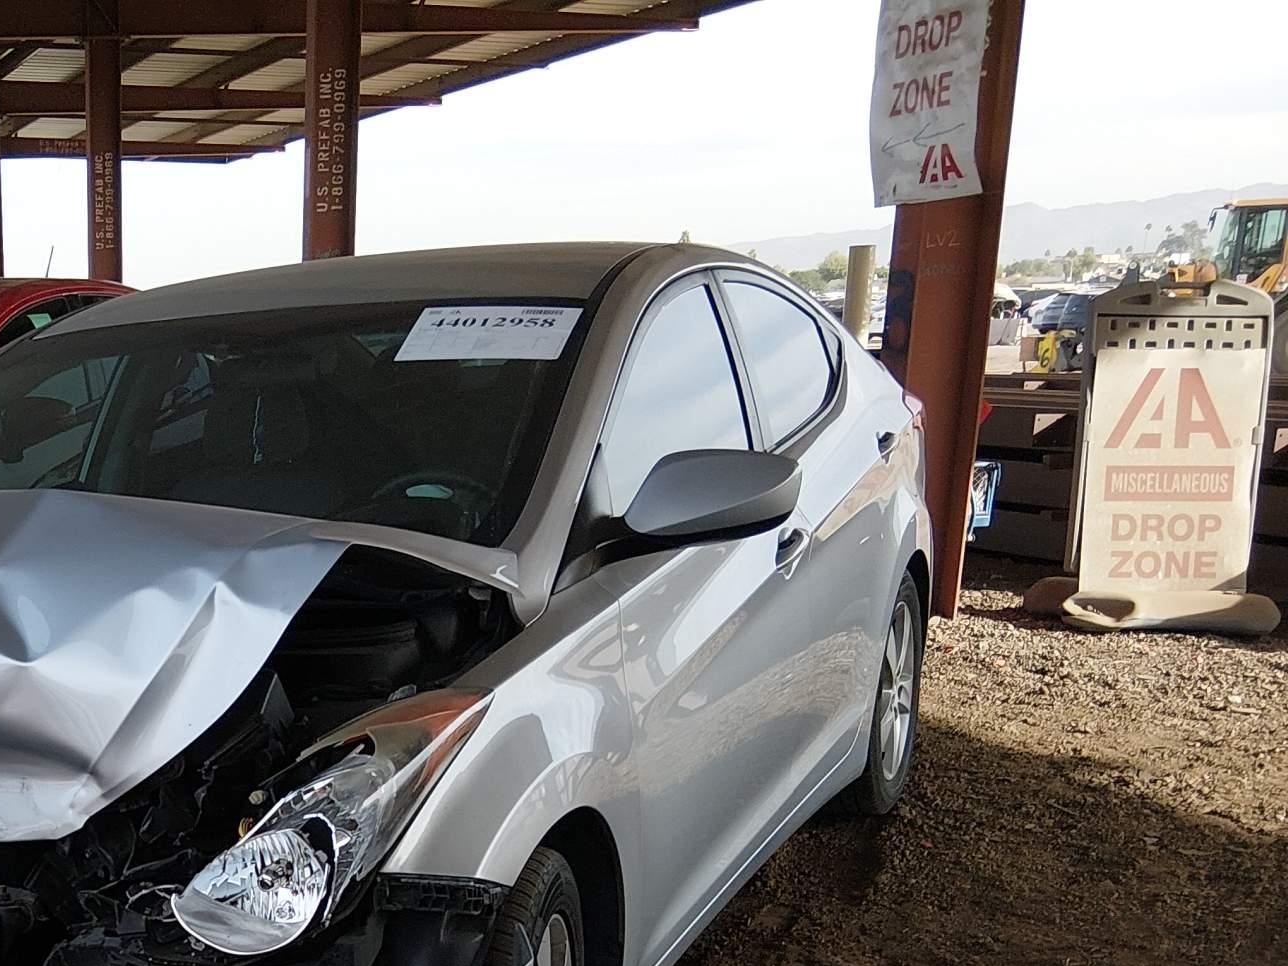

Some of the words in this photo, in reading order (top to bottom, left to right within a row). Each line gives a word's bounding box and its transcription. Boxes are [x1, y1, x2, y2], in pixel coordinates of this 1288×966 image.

[895, 10, 962, 59] DROP
[319, 67, 332, 99] INC.
[889, 71, 953, 118] ZONE
[317, 107, 331, 172] PREFAB
[331, 68, 347, 210] 1-866-799-0969
[94, 179, 105, 223] PREFAB
[316, 182, 329, 212] U.S.
[431, 317, 556, 328] 44012958
[1111, 472, 1229, 494] MISCELLANEOUS
[1111, 513, 1222, 542] DROP
[1108, 550, 1218, 579] ZONE
